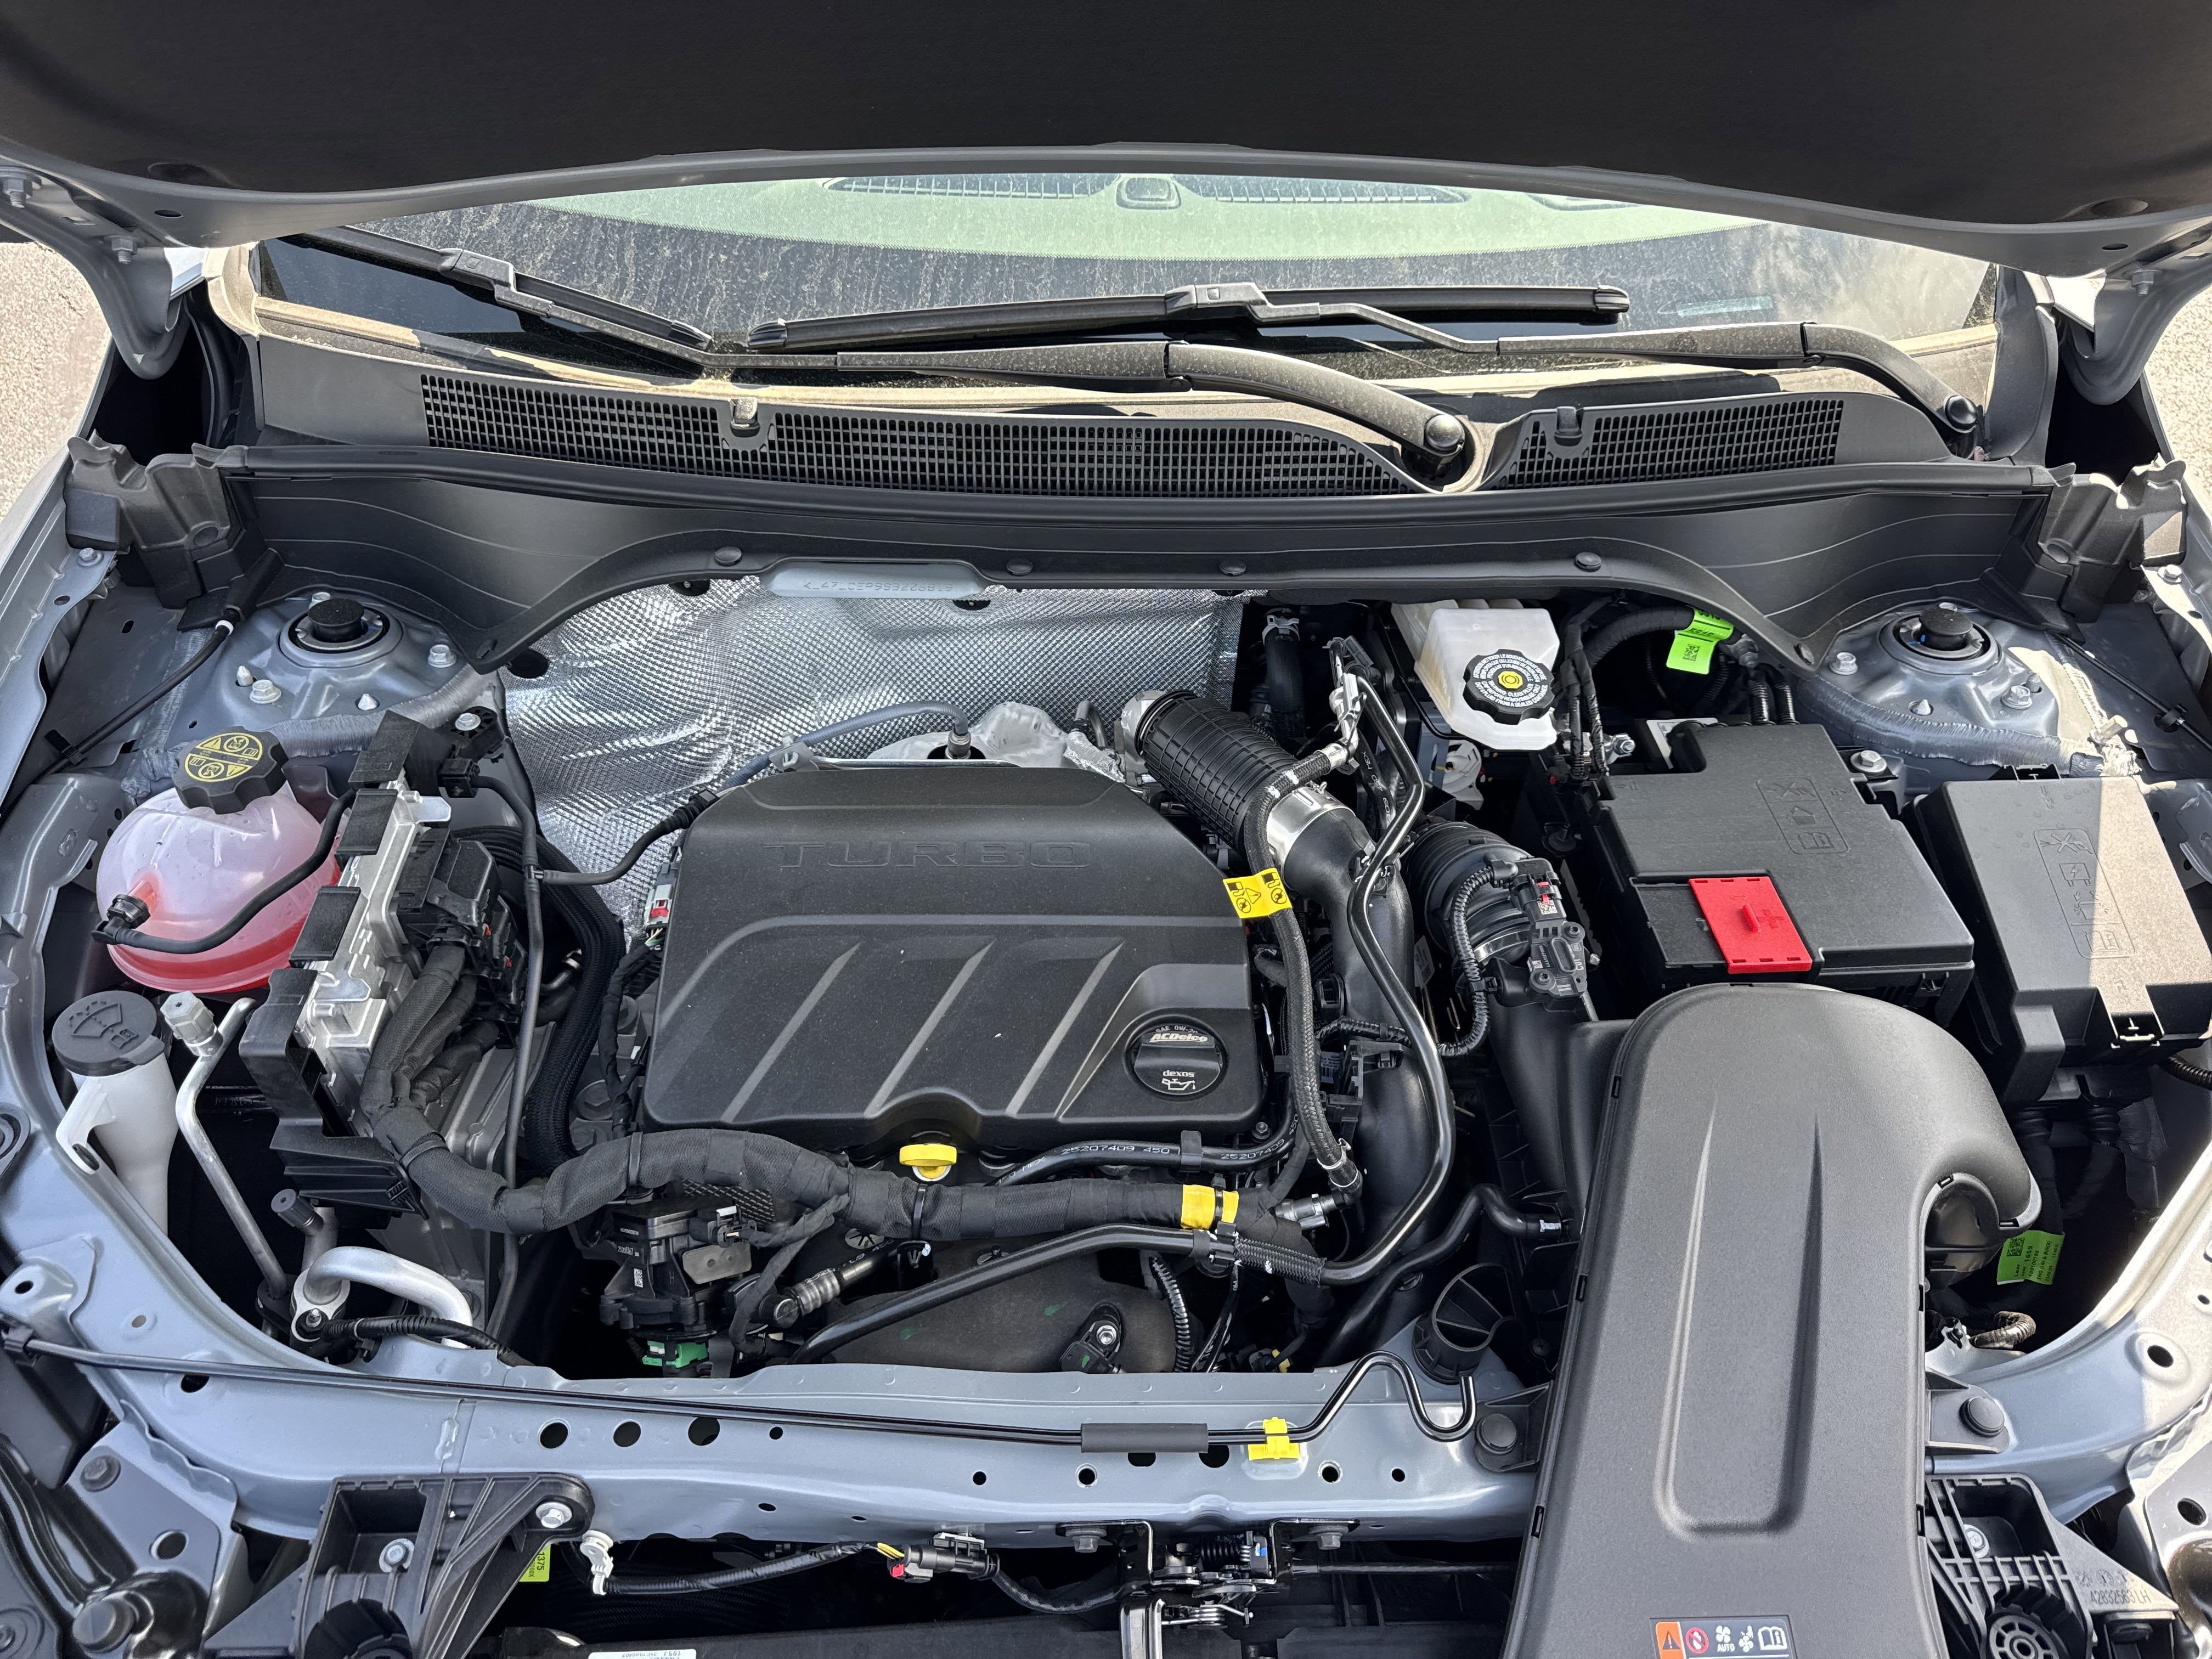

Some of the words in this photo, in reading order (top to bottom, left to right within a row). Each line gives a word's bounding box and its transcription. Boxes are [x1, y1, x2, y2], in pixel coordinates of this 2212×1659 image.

[1361, 751, 1373, 770] MEX
[763, 841, 1091, 868] TURBO
[1149, 1032, 1208, 1042] ACDelco
[1163, 1069, 1196, 1077] dexos
[1289, 1114, 1299, 1135] 450
[1060, 1144, 1135, 1155] 25207409
[1221, 1138, 1285, 1160] 25207409
[2024, 1245, 2033, 1262] 1659
[537, 1551, 546, 1571] 1375
[2134, 1589, 2151, 1604] LH
[1717, 1643, 1735, 1652] AUTO
